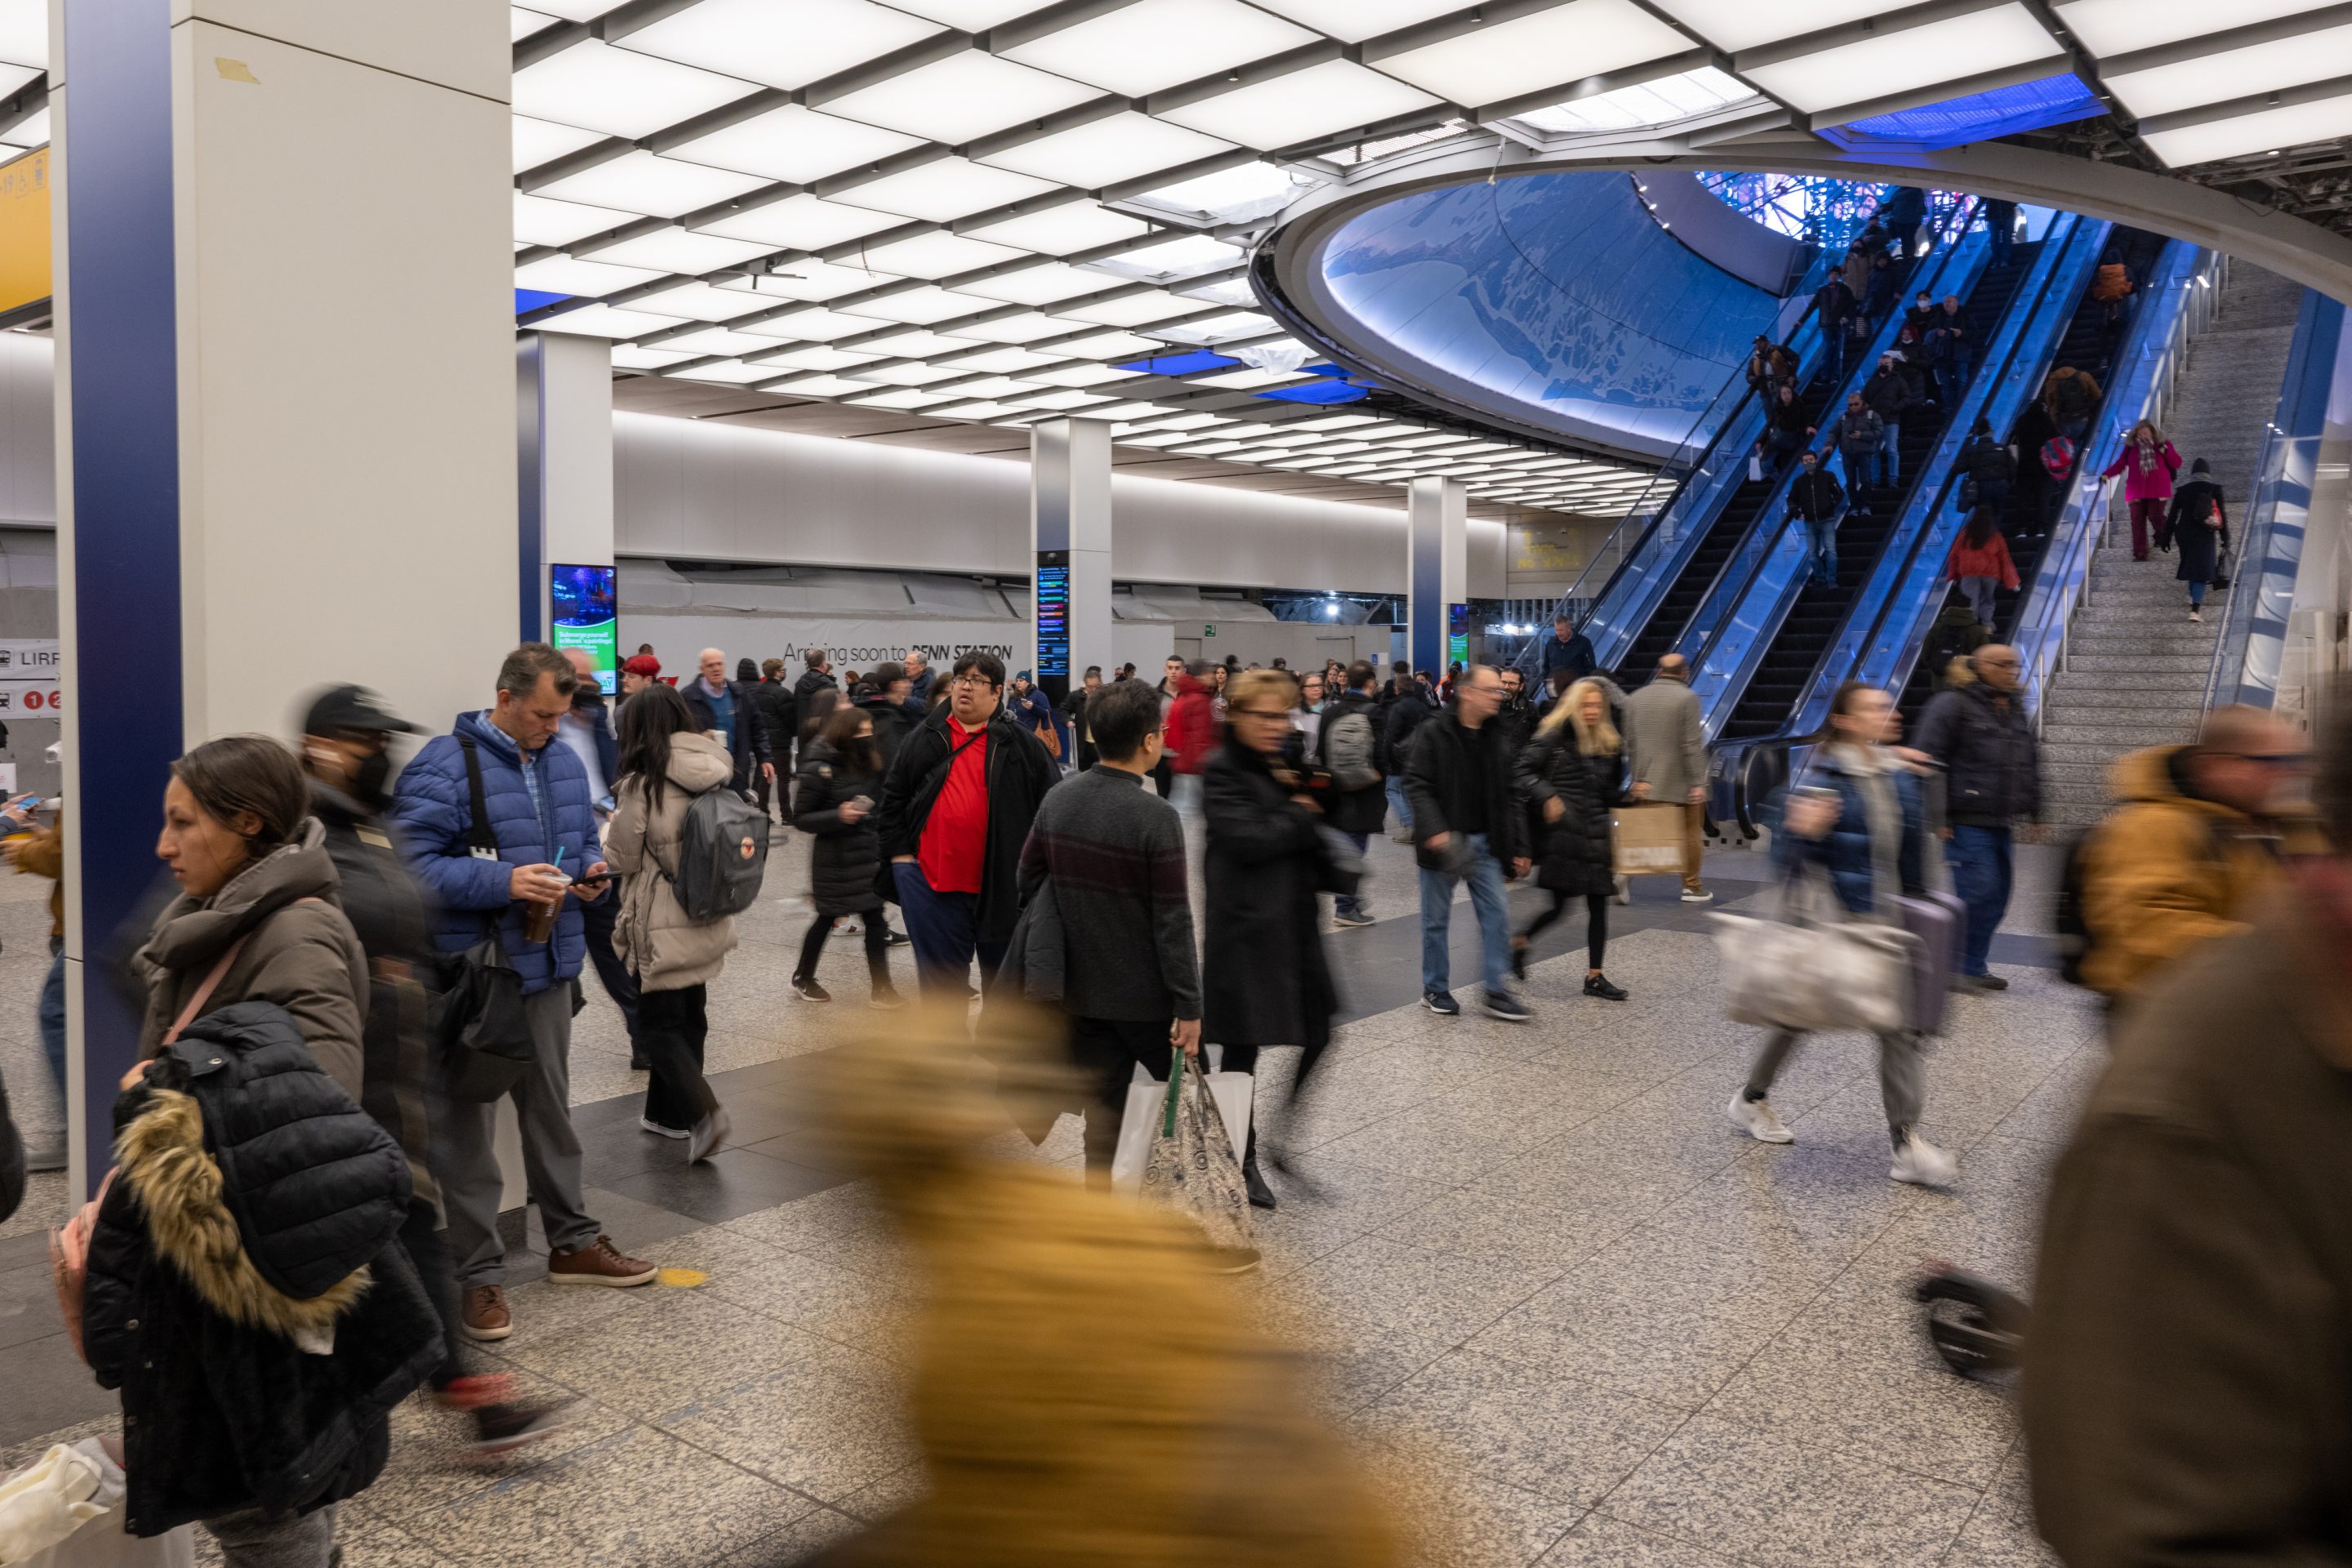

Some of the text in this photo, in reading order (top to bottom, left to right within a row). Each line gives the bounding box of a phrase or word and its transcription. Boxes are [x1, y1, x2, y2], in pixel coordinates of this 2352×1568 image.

[783, 643, 847, 666] Arrng
[850, 648, 888, 662] soon
[890, 645, 907, 662] to
[954, 644, 1013, 661] STTION
